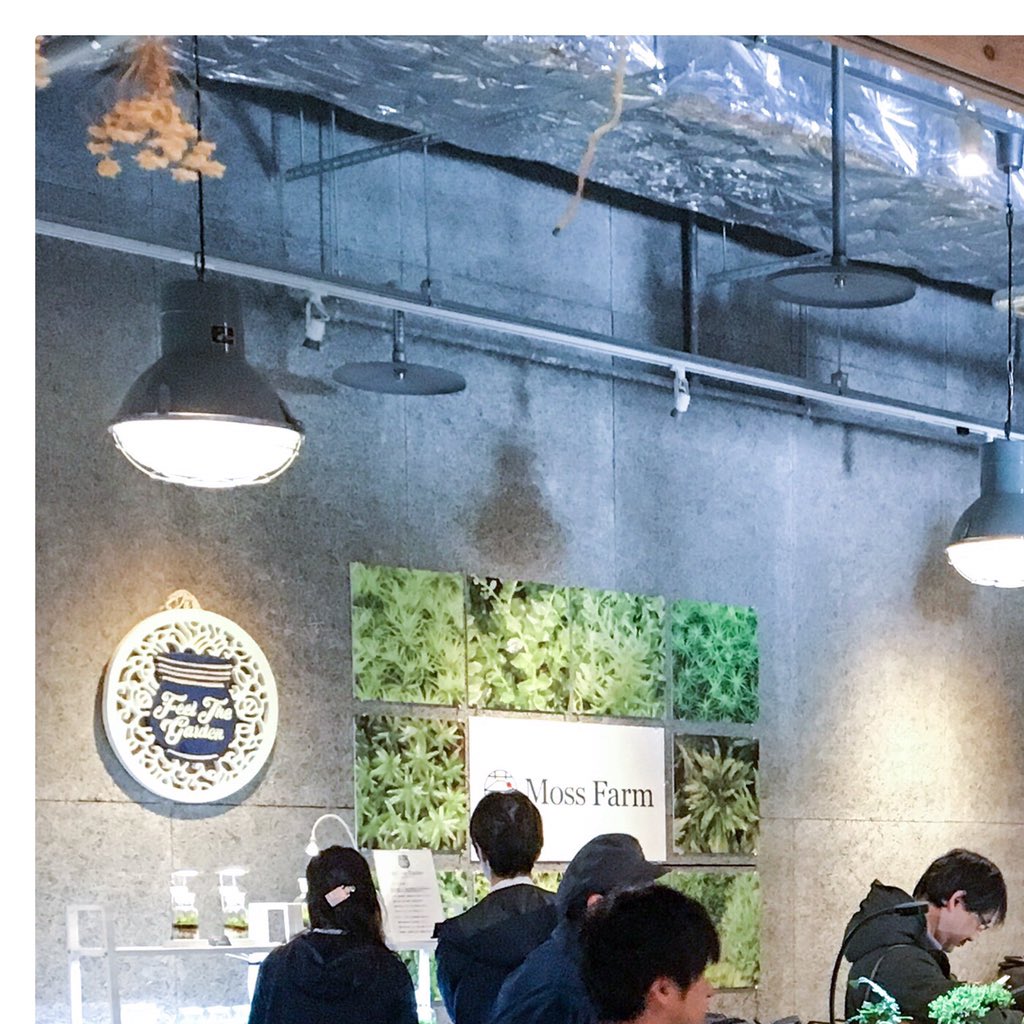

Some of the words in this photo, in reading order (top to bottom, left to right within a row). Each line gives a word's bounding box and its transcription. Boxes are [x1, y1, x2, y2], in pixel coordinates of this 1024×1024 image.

[153, 691, 198, 719] Feel
[197, 696, 233, 724] The
[160, 716, 225, 745] Garden
[526, 778, 587, 806] Moss
[593, 780, 654, 807] Farm
